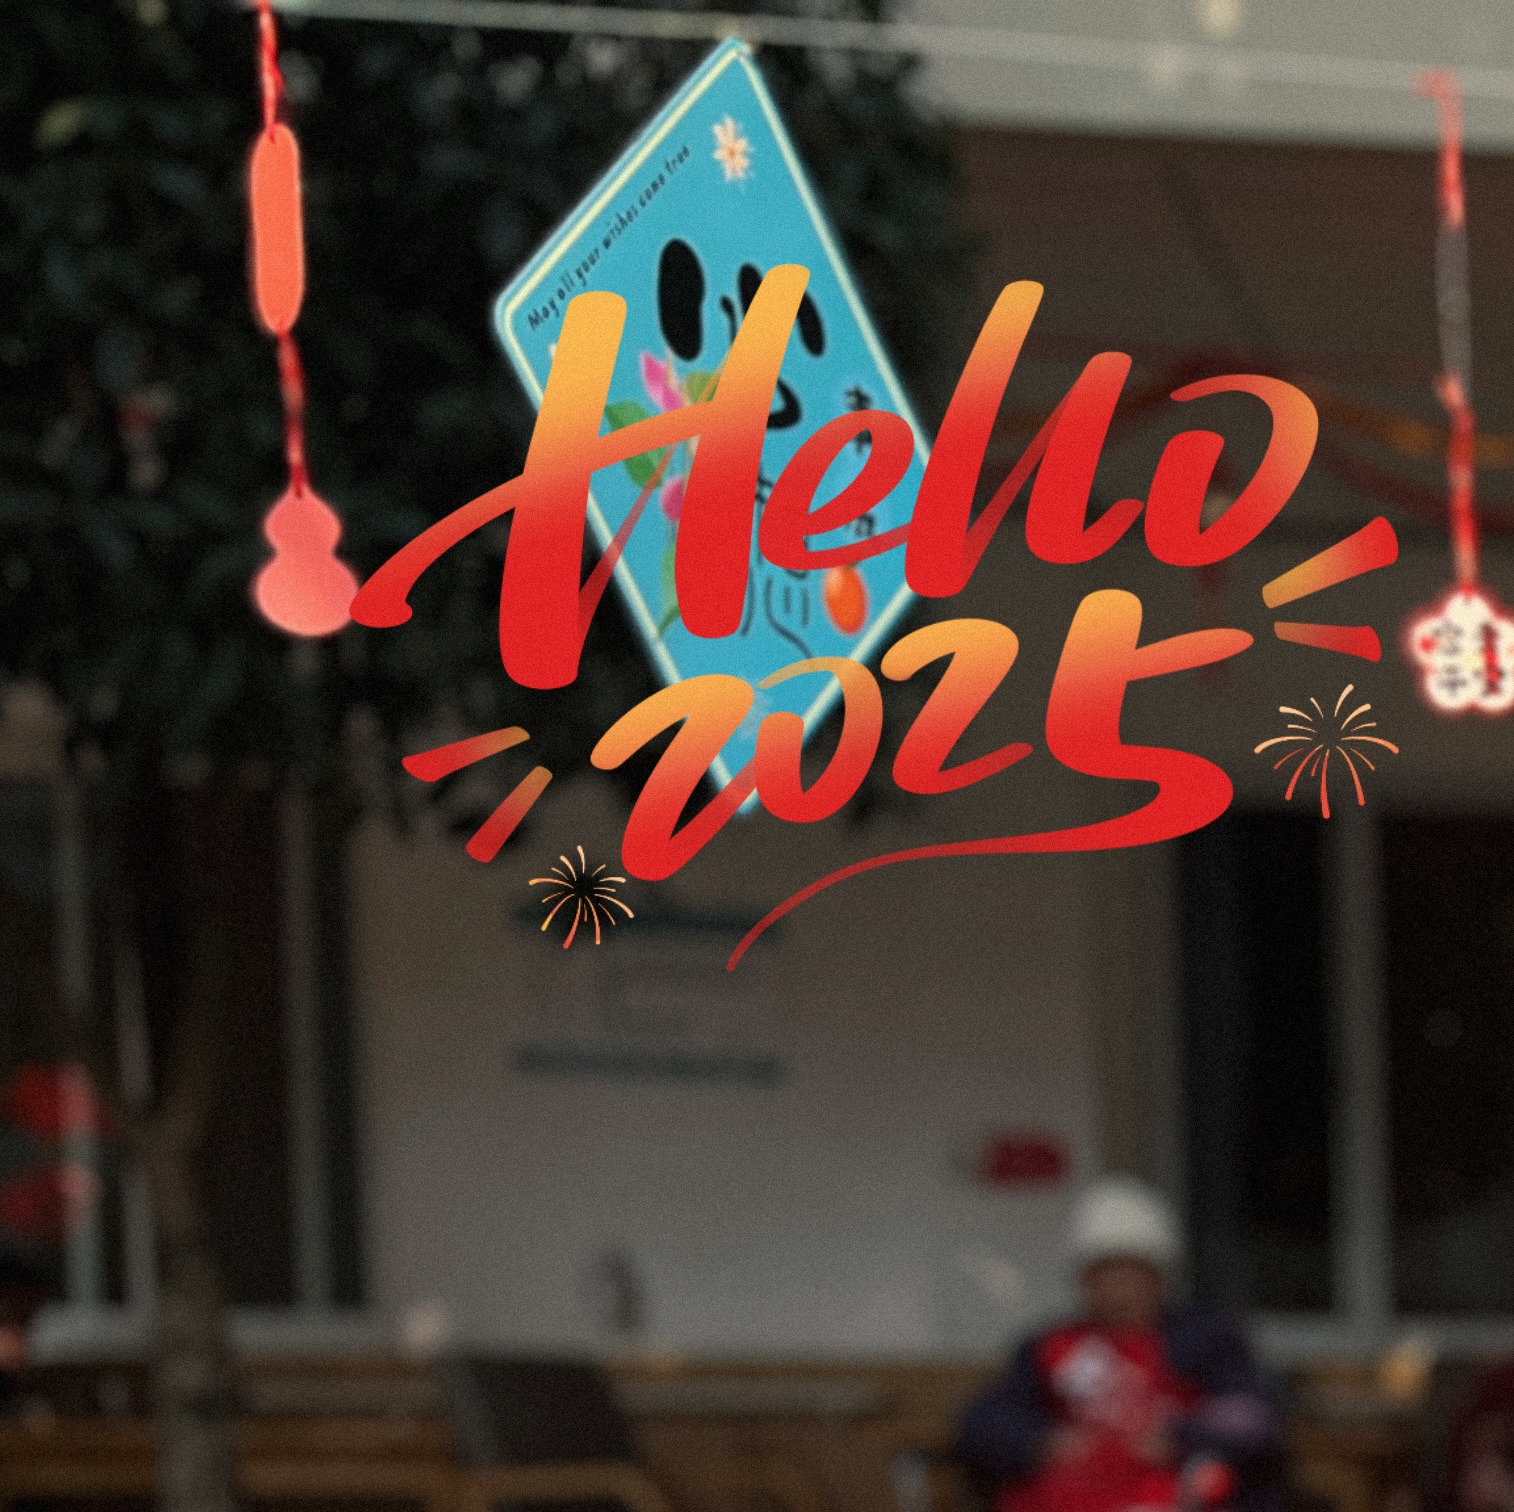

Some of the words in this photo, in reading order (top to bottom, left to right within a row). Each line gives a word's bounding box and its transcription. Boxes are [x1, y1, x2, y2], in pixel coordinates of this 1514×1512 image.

[528, 299, 560, 330] May
[559, 272, 575, 299] all
[576, 248, 600, 288] your
[602, 204, 639, 249] wishes
[639, 173, 665, 208] come
[665, 145, 690, 176] true
